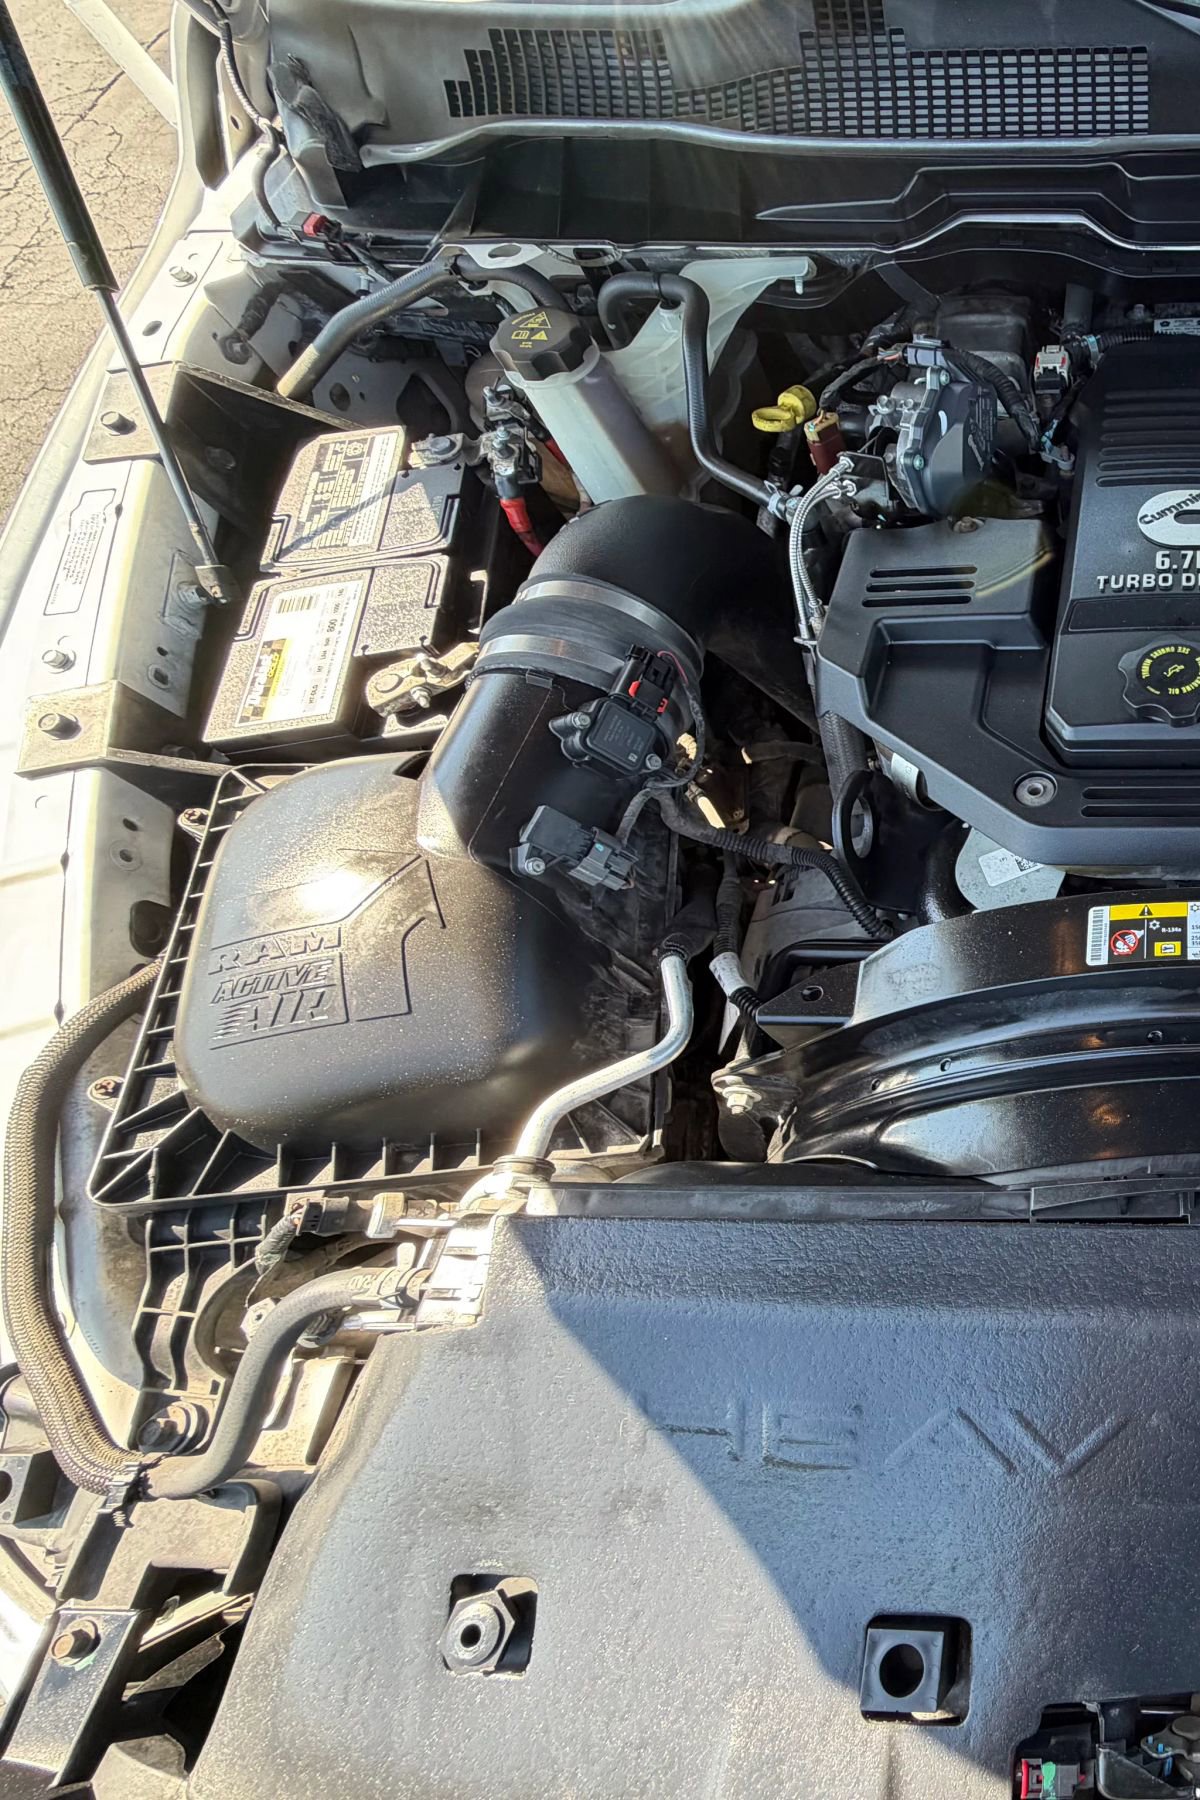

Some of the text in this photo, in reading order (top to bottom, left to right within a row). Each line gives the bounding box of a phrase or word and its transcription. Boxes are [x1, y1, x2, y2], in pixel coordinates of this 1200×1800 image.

[1097, 573, 1173, 590] TURBO
[326, 618, 338, 632] 800
[208, 927, 342, 975] RAM
[211, 958, 334, 1003] ACTIVE
